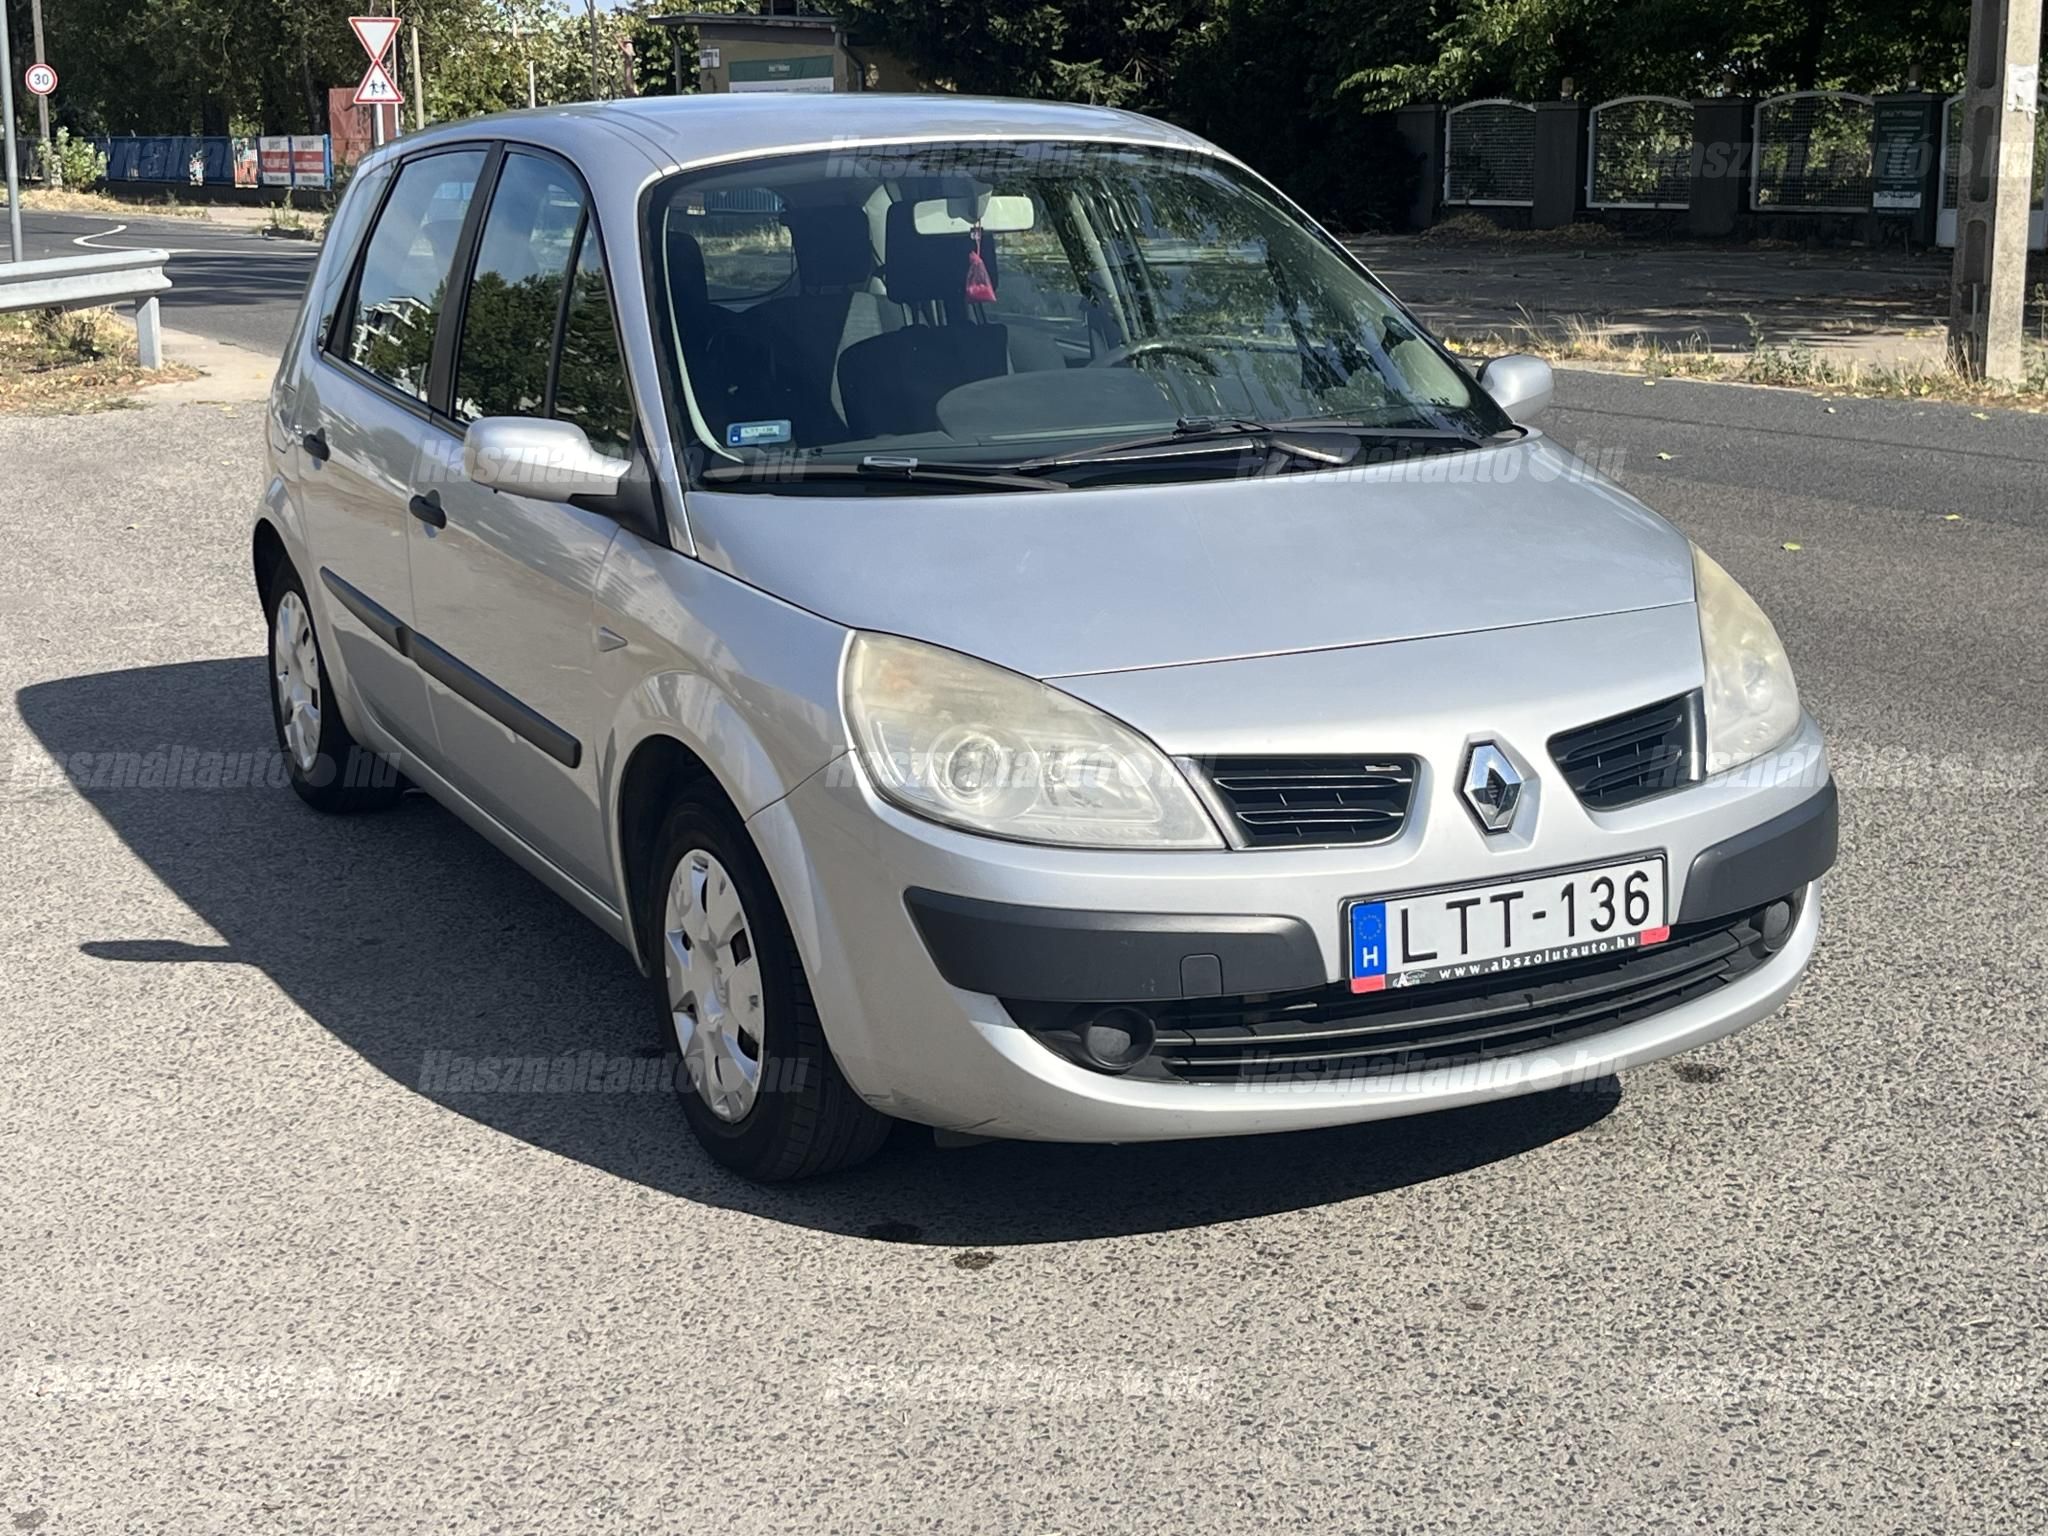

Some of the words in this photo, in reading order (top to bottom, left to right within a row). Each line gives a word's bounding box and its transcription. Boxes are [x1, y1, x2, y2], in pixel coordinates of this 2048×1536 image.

[34, 73, 49, 85] 30
[1400, 870, 1650, 964] LTT-136
[1362, 946, 1379, 969] H
[1439, 936, 1636, 980] www.abszolutauto.hu
